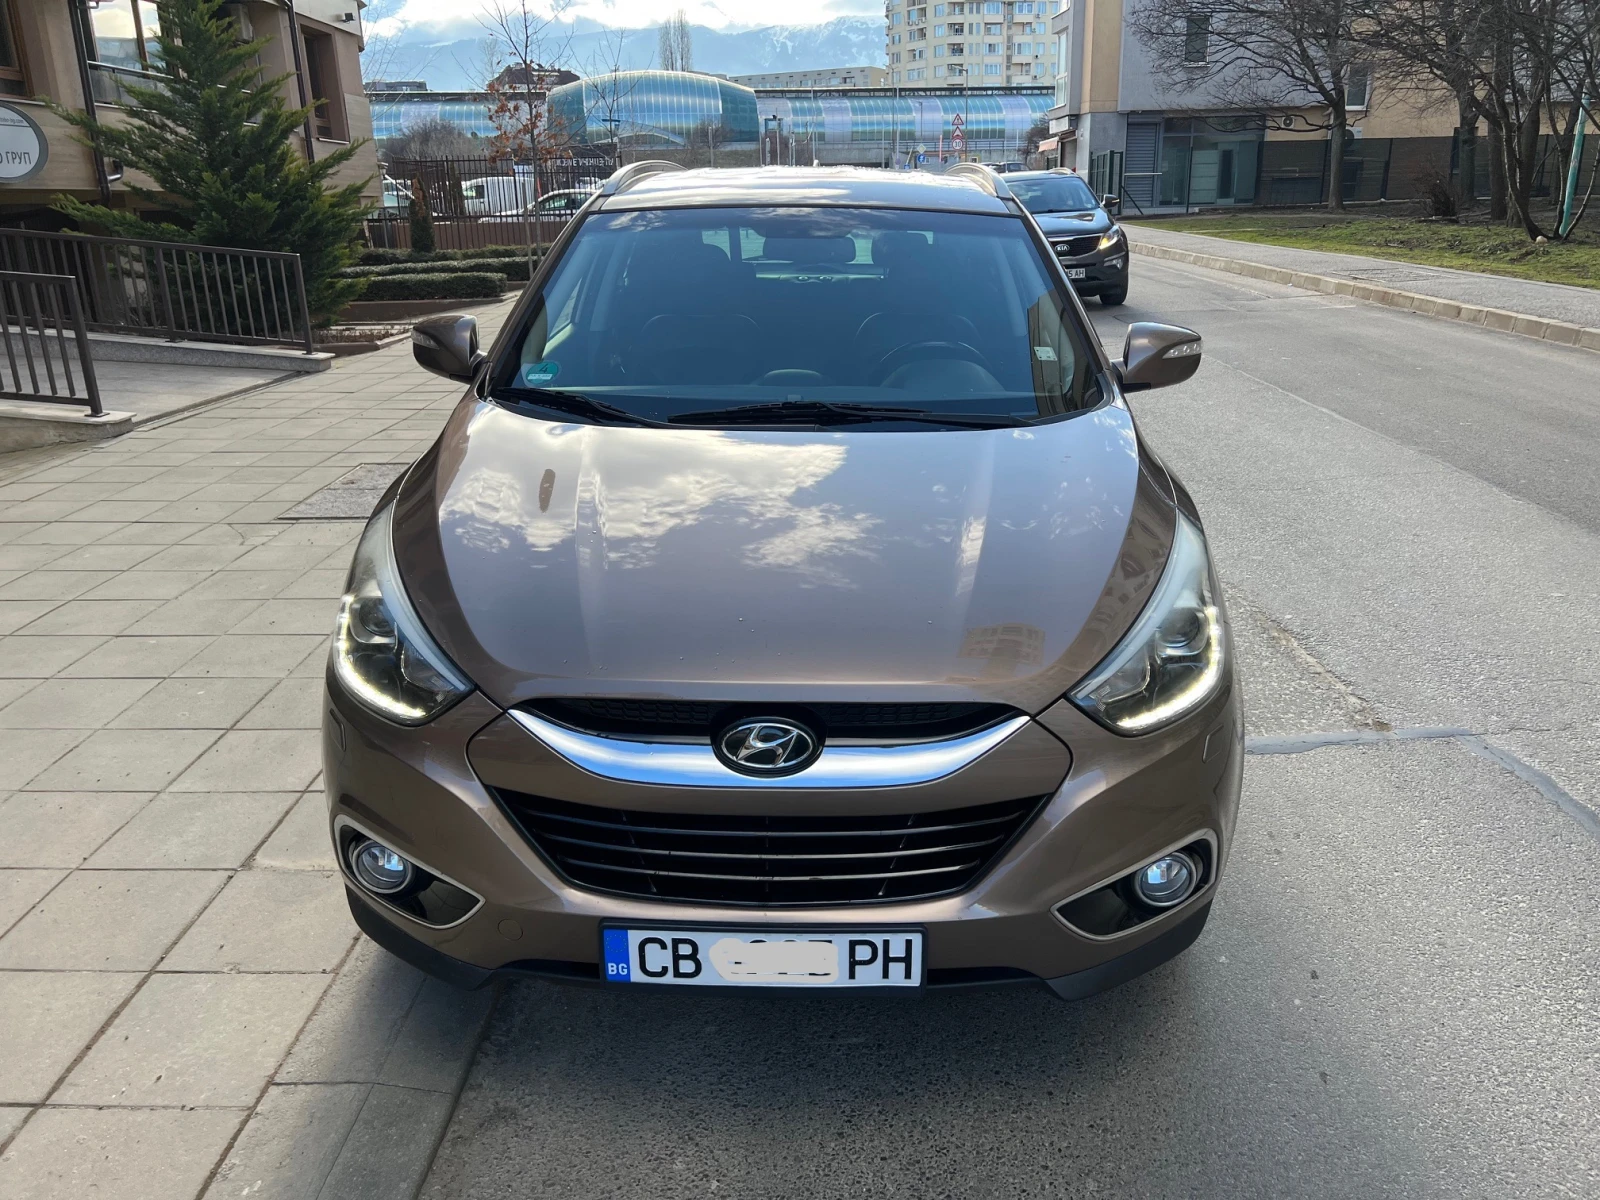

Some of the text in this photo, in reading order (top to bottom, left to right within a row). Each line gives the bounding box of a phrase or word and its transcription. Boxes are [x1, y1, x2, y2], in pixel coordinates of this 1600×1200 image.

[5, 151, 32, 165] ГРУП
[638, 937, 702, 978] CB
[848, 939, 913, 980] PH
[607, 962, 628, 975] BG
